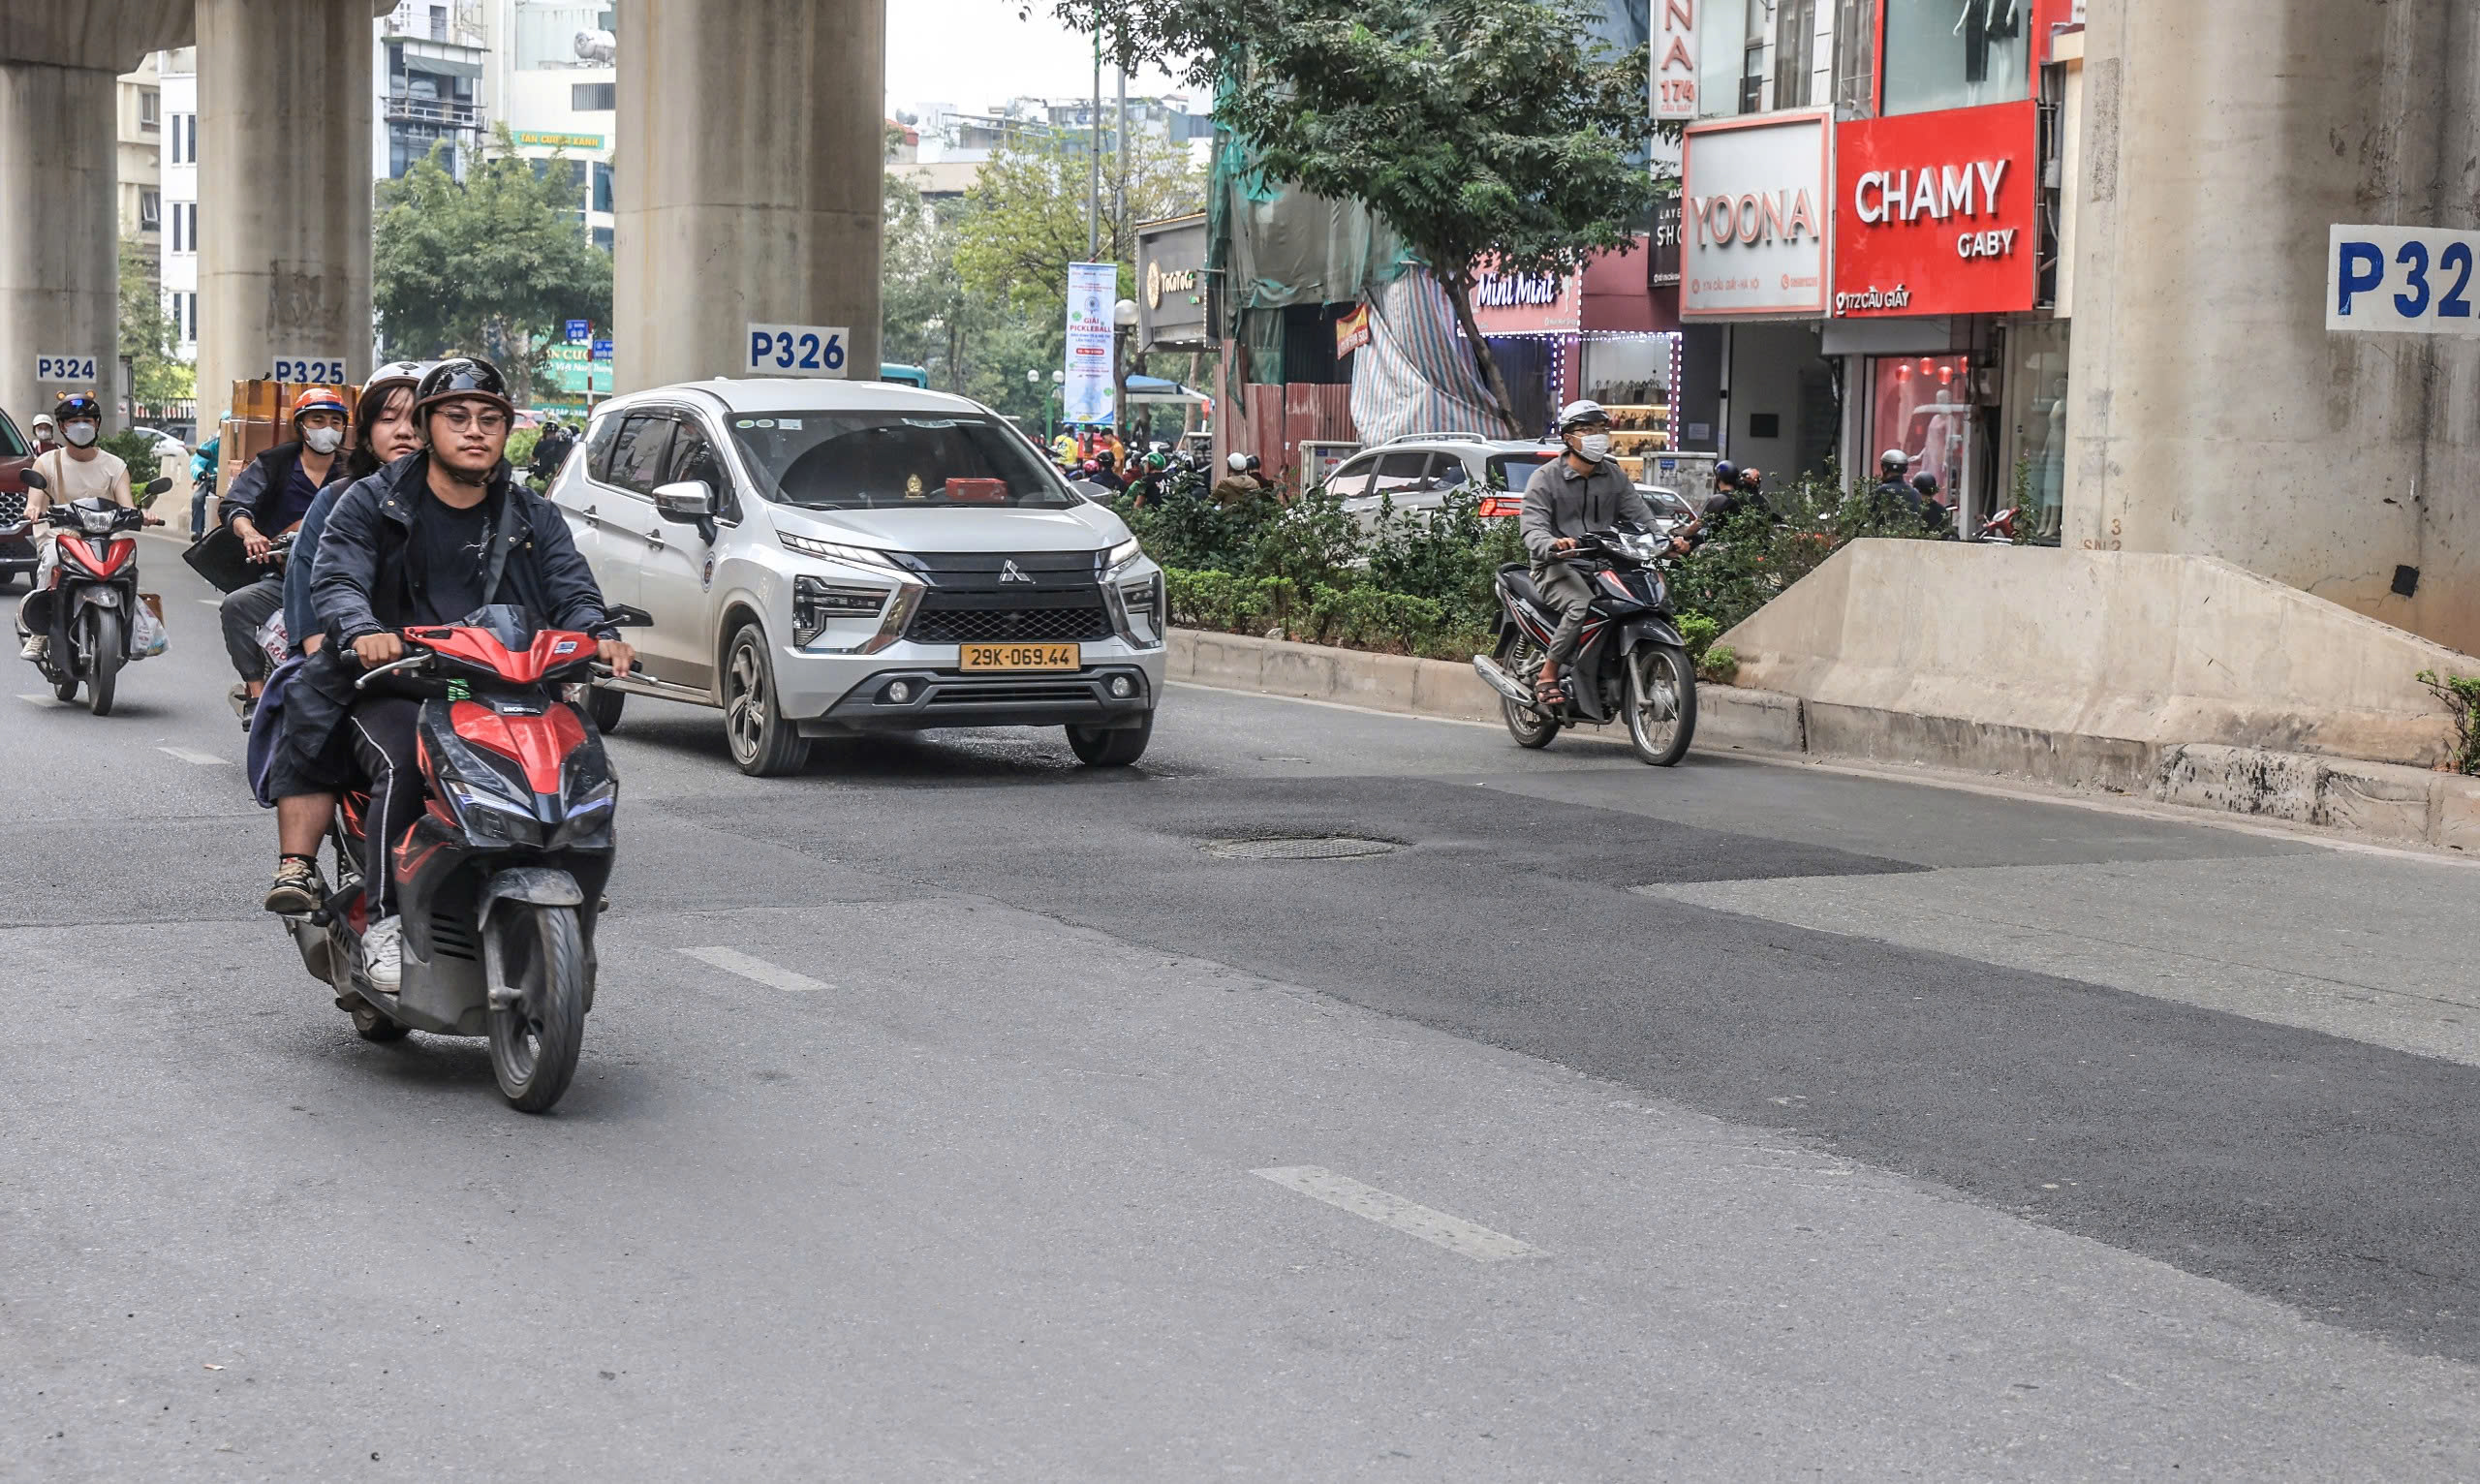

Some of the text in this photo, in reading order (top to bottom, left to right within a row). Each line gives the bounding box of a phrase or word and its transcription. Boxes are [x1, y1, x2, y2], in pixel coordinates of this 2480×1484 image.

[1659, 80, 1694, 102] 174
[1855, 160, 2007, 224] CHAMY
[1690, 187, 1818, 246] YOONA
[1957, 229, 2014, 259] GABY
[1515, 270, 1555, 305] Mint
[2339, 240, 2480, 319] P32
[1845, 284, 1909, 309] 172 CẦU GIẤY
[1070, 325, 1111, 333] PICKLEBALL
[752, 331, 845, 370] P326
[39, 358, 95, 378] P324
[276, 360, 344, 385] P325
[2111, 518, 2122, 536] 3
[971, 648, 1070, 665] 29K-069.44
